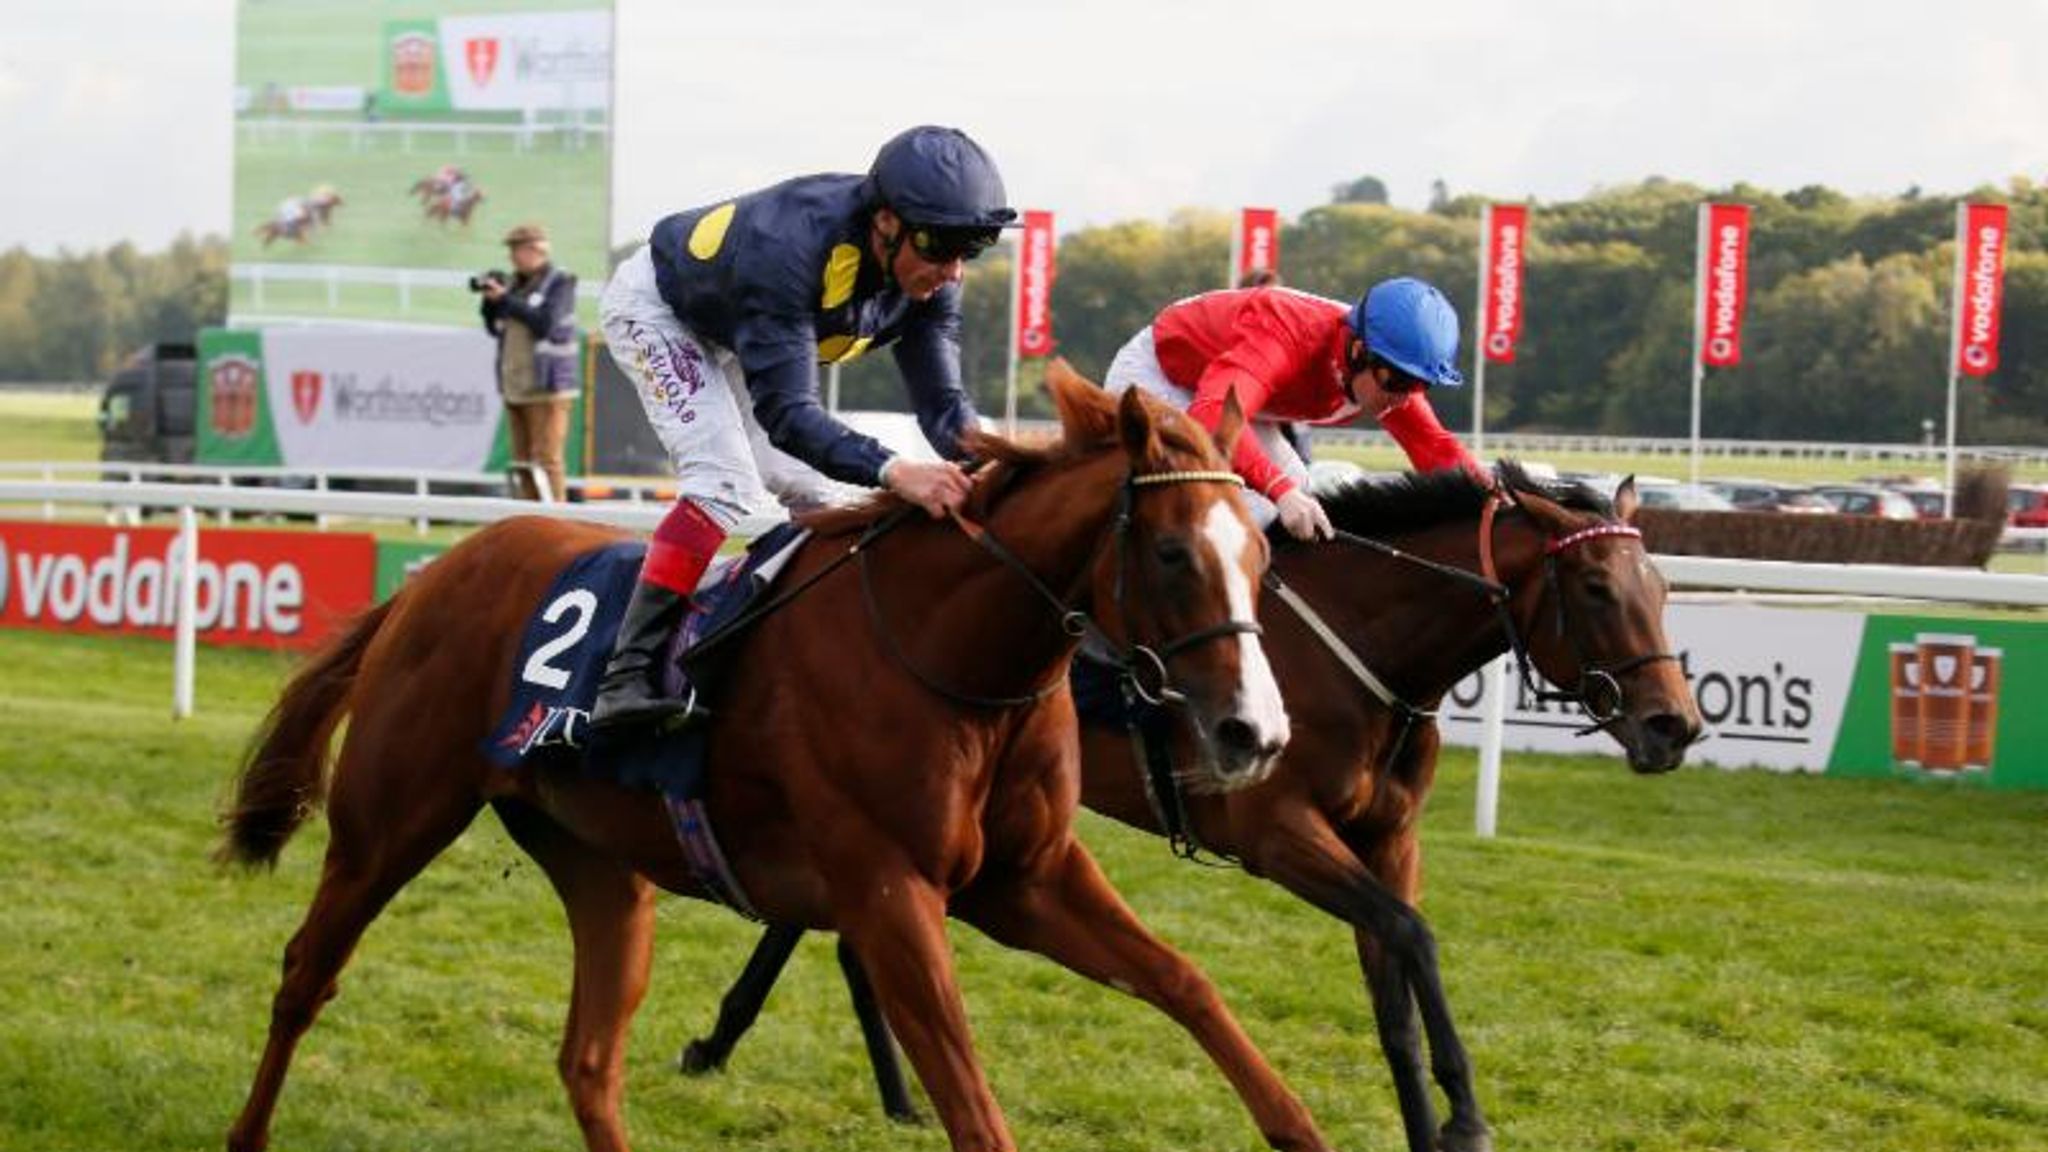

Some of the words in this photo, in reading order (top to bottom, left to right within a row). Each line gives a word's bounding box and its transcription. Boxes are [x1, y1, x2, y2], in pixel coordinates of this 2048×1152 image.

[1494, 224, 1518, 332] vodafone
[1714, 224, 1740, 335] vodafone
[1971, 226, 1999, 343] vodafone
[17, 533, 303, 634] vodafone
[522, 588, 598, 690] 2
